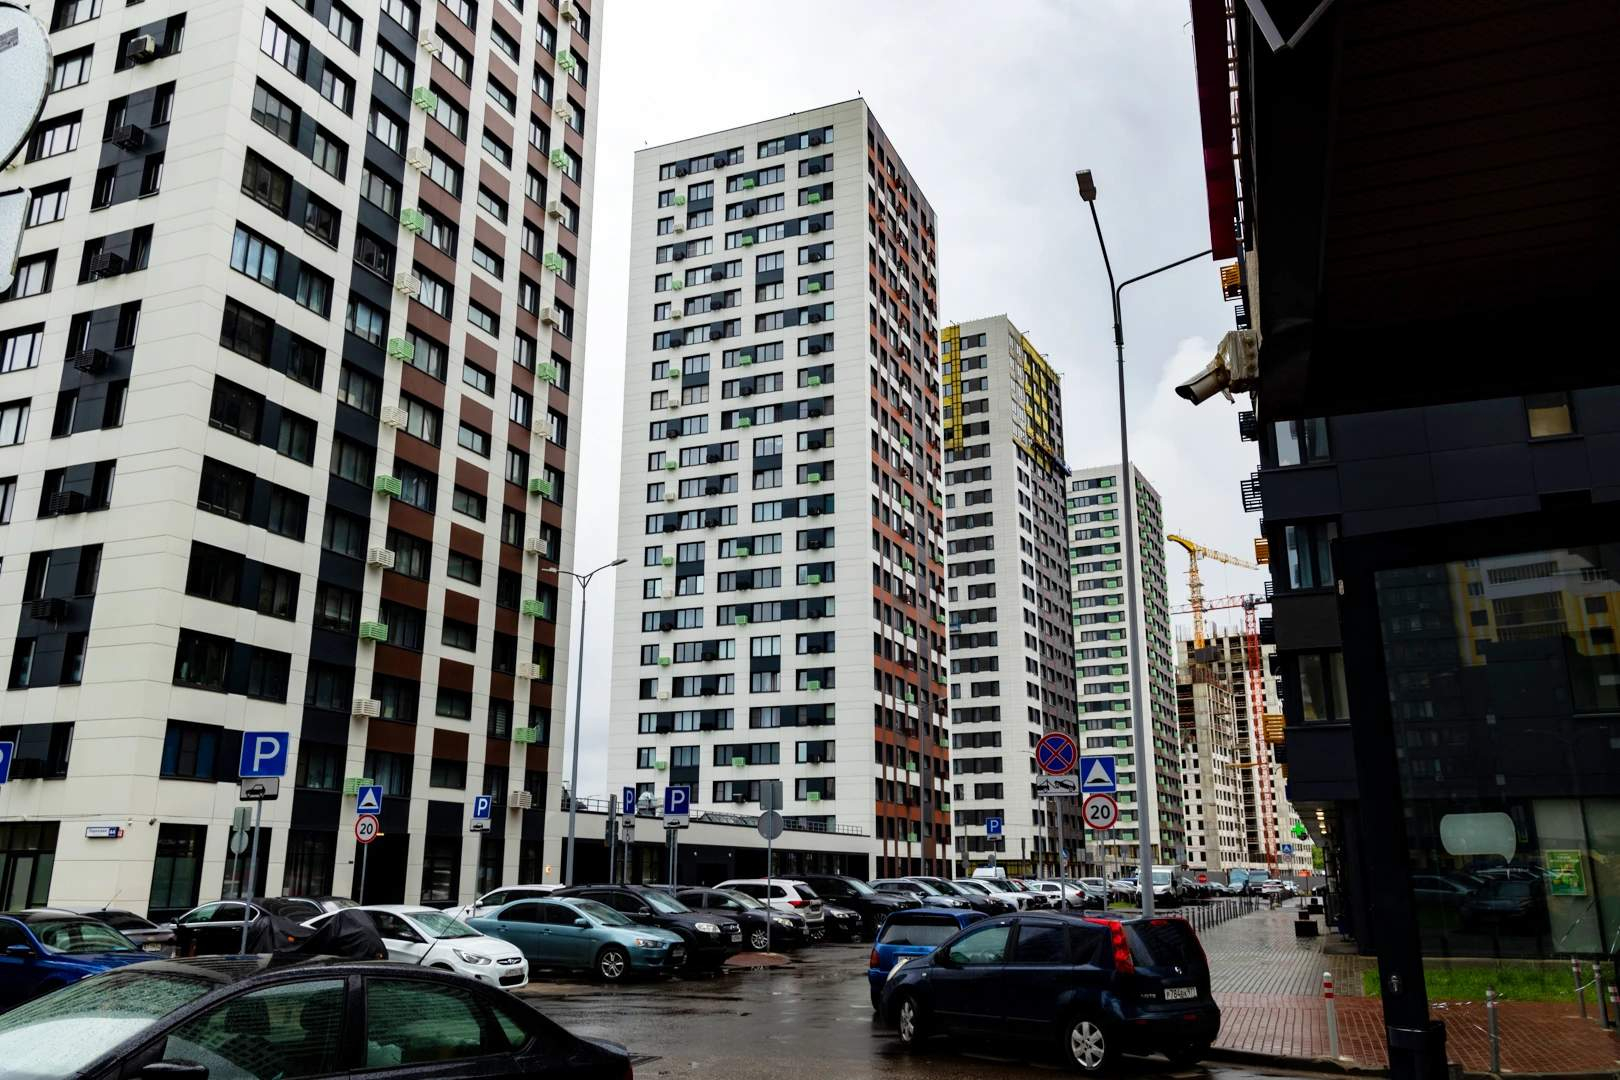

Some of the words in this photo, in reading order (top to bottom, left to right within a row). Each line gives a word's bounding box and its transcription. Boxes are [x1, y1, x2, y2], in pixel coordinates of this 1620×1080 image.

[253, 736, 280, 772] P
[477, 798, 488, 816] P
[626, 790, 634, 812] P
[671, 789, 685, 812] P
[1090, 805, 1111, 820] 20
[360, 823, 373, 835] 20
[991, 820, 999, 833] P
